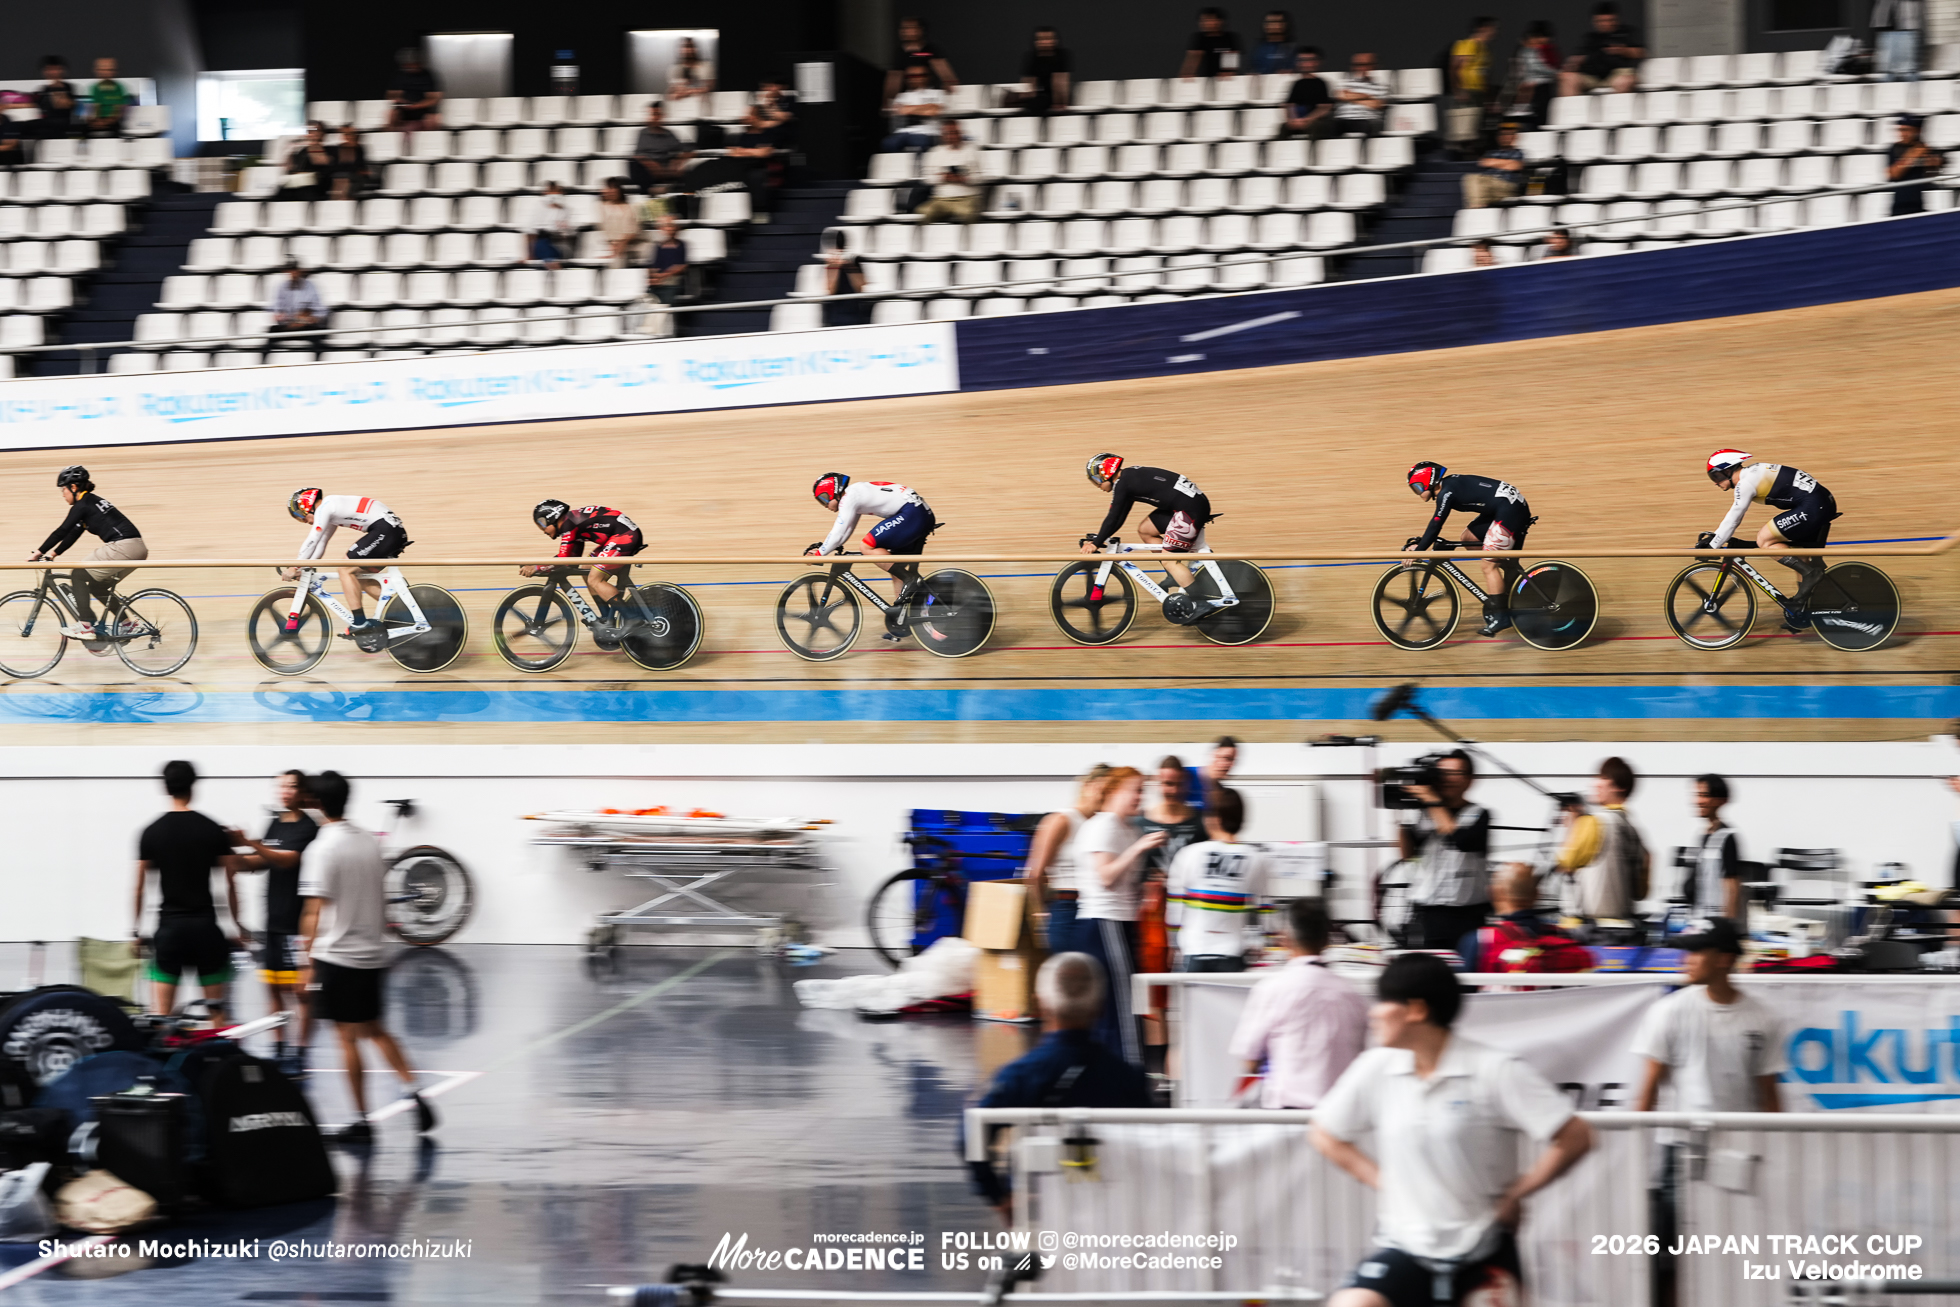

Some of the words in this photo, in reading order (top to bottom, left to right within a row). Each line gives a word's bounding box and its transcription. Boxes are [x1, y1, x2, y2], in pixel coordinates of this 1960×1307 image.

[874, 515, 905, 537] JAPAN
[841, 571, 890, 611] BRIDGESTONE
[1441, 561, 1489, 602] BRIDGESTONE
[1732, 557, 1783, 598] LOOK
[1778, 1010, 1960, 1084] aku
